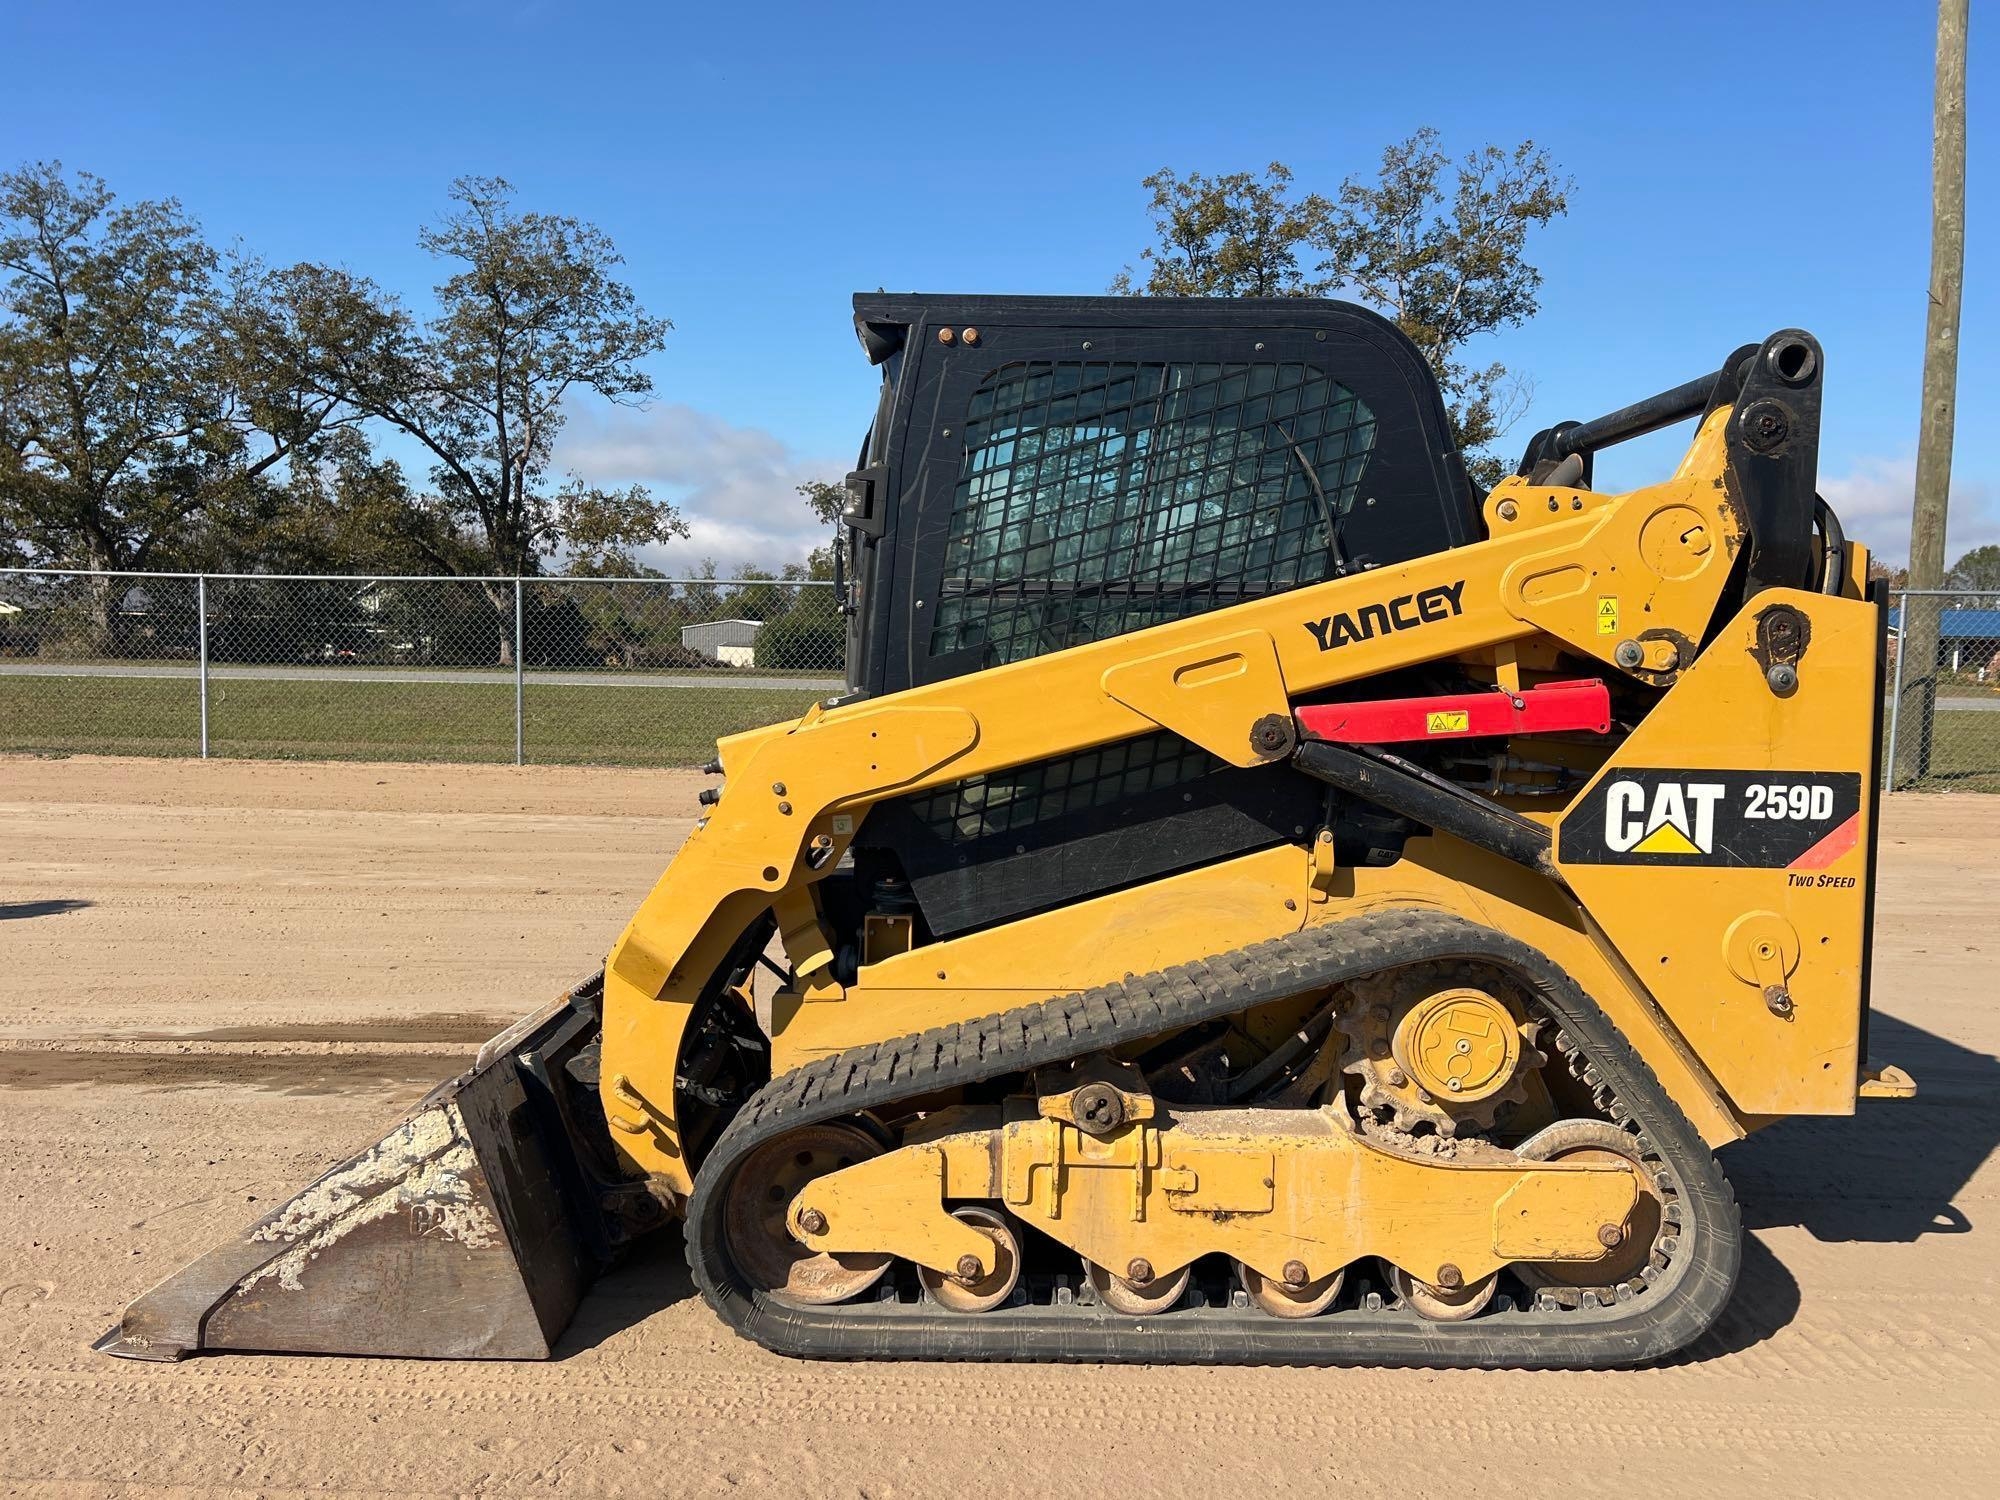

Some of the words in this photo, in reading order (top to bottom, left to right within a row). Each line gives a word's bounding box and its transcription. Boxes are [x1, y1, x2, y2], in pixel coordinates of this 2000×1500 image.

[1303, 580, 1466, 652] YANCEY
[1605, 780, 1726, 854] CAT
[1743, 784, 1834, 821] 259D
[410, 1204, 465, 1241] CA
